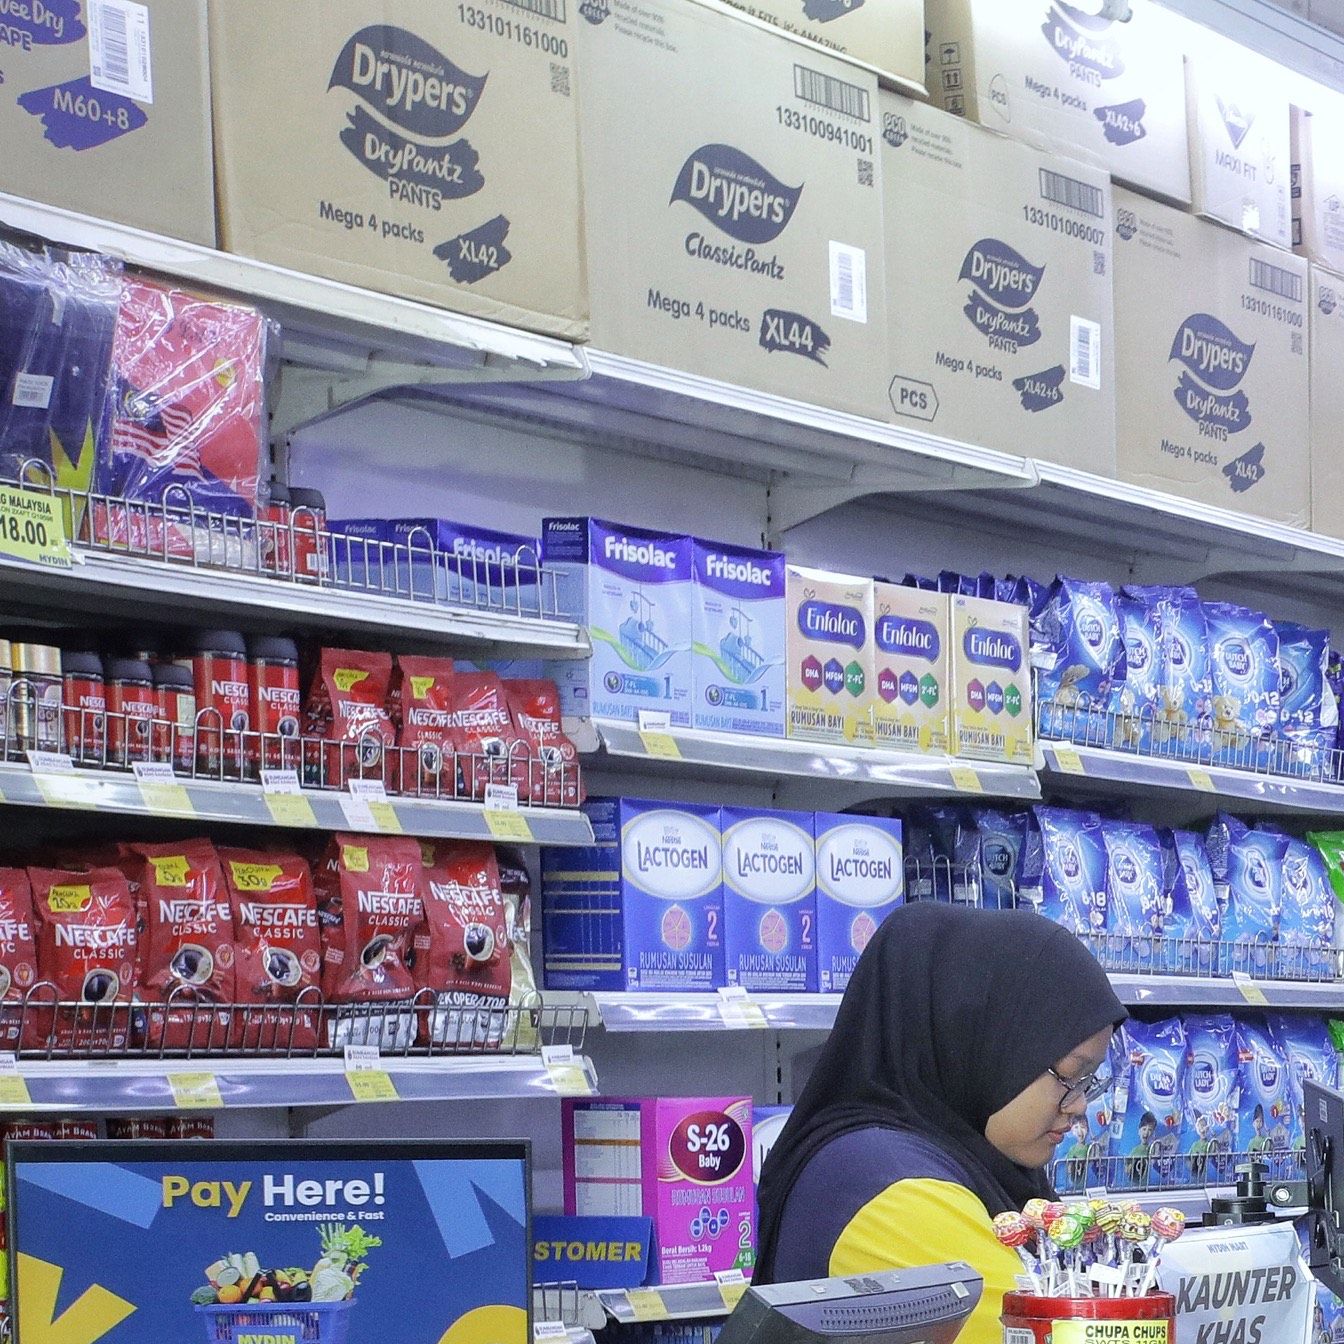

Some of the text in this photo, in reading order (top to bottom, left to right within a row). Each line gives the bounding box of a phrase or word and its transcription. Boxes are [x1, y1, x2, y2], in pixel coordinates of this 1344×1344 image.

[457, 4, 568, 59] 133101161000
[352, 42, 467, 116] Drypers
[53, 89, 129, 130] M60+8
[775, 105, 873, 155] 133100941001
[365, 133, 464, 184] DryPantz
[388, 177, 442, 211] PANTS
[691, 159, 786, 224] Drypers
[319, 201, 424, 243] Mega 4 packs
[1023, 205, 1105, 246] 133101006007
[459, 239, 499, 268] XL42
[685, 232, 785, 280] ClassicPantz
[972, 251, 1035, 294] Drypers
[647, 289, 750, 332] Mega 4 packs
[976, 306, 1030, 337] DryPantz
[765, 314, 814, 351] XL44
[988, 335, 1018, 354] PANTS
[1181, 327, 1246, 374] Drypers
[935, 351, 1003, 381] Mega 4 packs
[899, 389, 928, 410] PCS
[1186, 390, 1240, 422] DryPantz
[1235, 458, 1258, 480] XL42
[548, 522, 580, 532] Frisolac
[605, 536, 676, 569] Frisolac
[706, 554, 772, 586] Frisolac
[807, 607, 858, 637] Enfalac
[882, 622, 932, 650] Enfalac
[971, 634, 1015, 660] Enfalac
[805, 668, 844, 682] DHA MFGM
[881, 679, 919, 694] DHA MFGM
[791, 709, 844, 729] RUMUSAN BAYI
[960, 729, 990, 745] RUMUSAN
[637, 840, 708, 872] LACTOGEN
[737, 851, 802, 877] LACTOGEN
[830, 852, 892, 881] LACTOGEN
[368, 915, 409, 927] CLASSIC
[707, 910, 717, 940] 2
[74, 948, 125, 960] CLASSIC
[640, 953, 713, 971] RUMUSAN SUSULAN
[687, 1123, 730, 1152] S-26
[699, 1153, 721, 1171] Baby
[162, 1172, 386, 1218] Pay Here!
[264, 1210, 384, 1223] Convenience & Fast
[739, 1221, 752, 1249] 2
[1176, 1266, 1297, 1313] KAUNTER
[1085, 1324, 1166, 1340] CHUPA CHUPS
